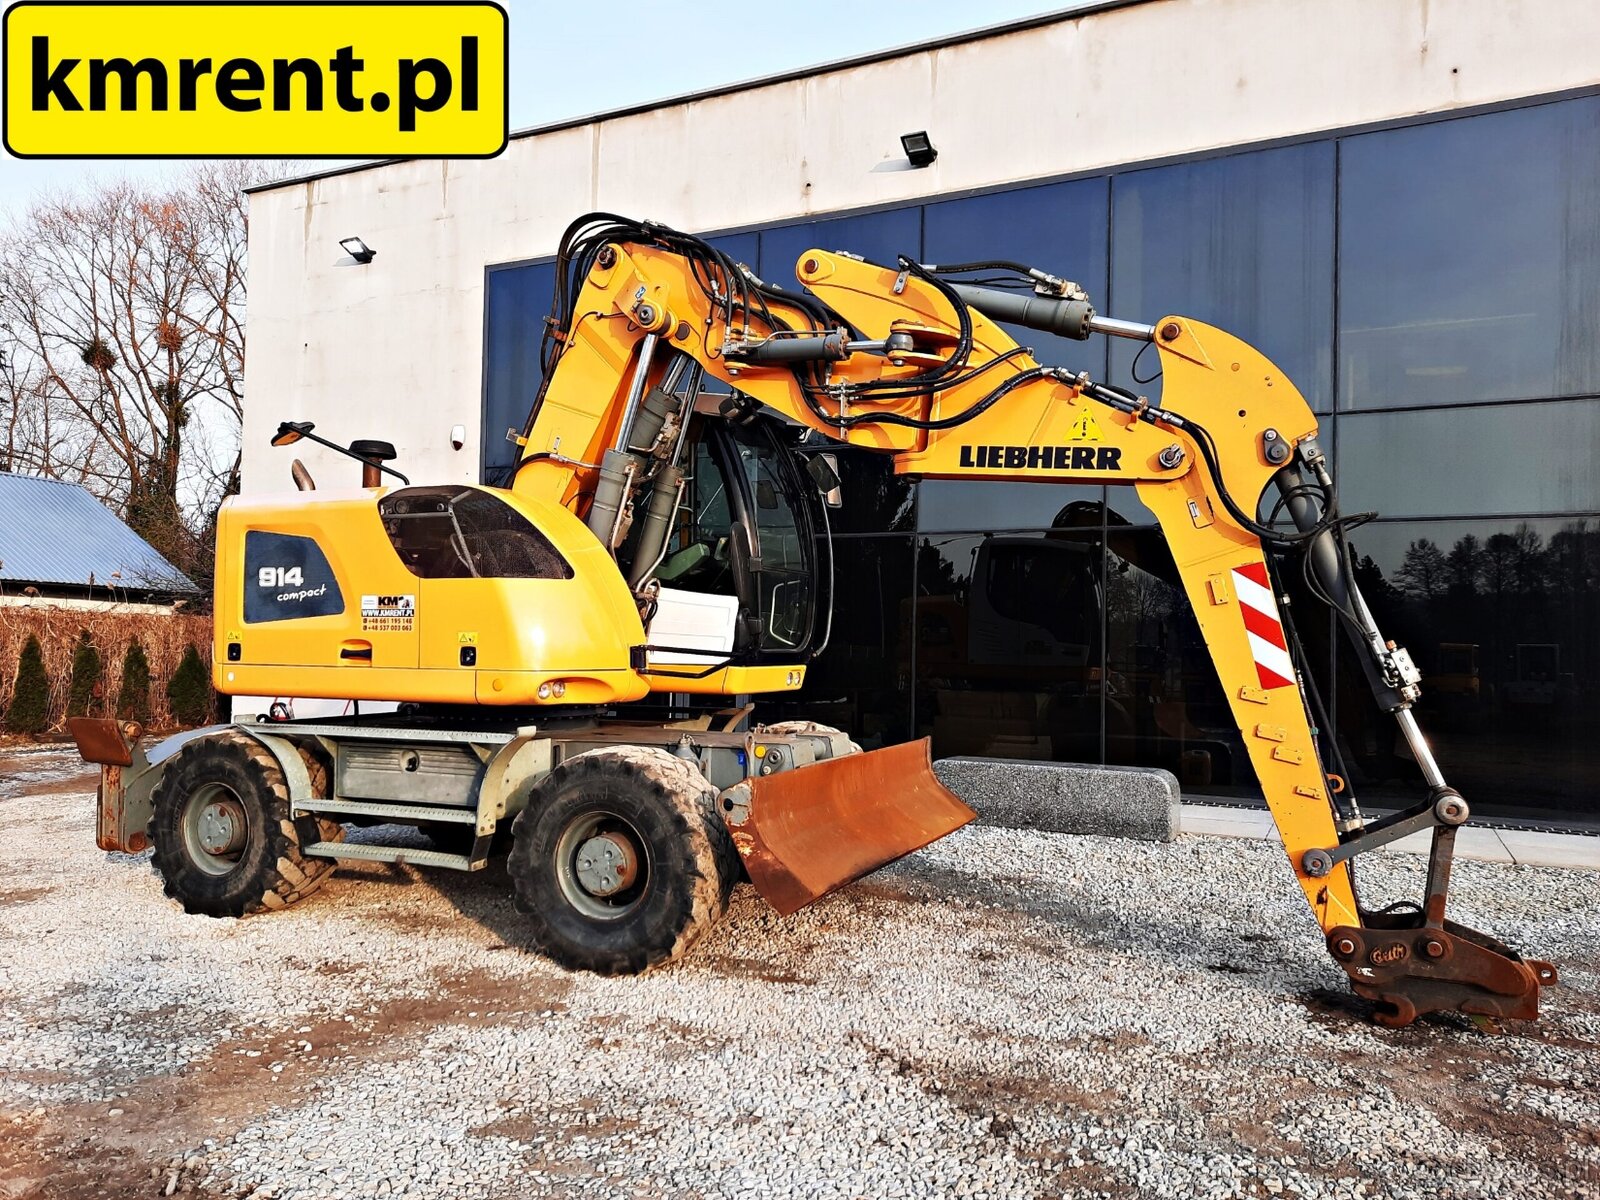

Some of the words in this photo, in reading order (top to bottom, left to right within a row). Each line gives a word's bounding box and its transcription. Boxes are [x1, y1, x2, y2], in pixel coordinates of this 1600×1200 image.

[959, 445, 1122, 471] LIEBHERR
[258, 566, 304, 587] 914
[276, 583, 327, 602] compact
[378, 596, 398, 606] KM
